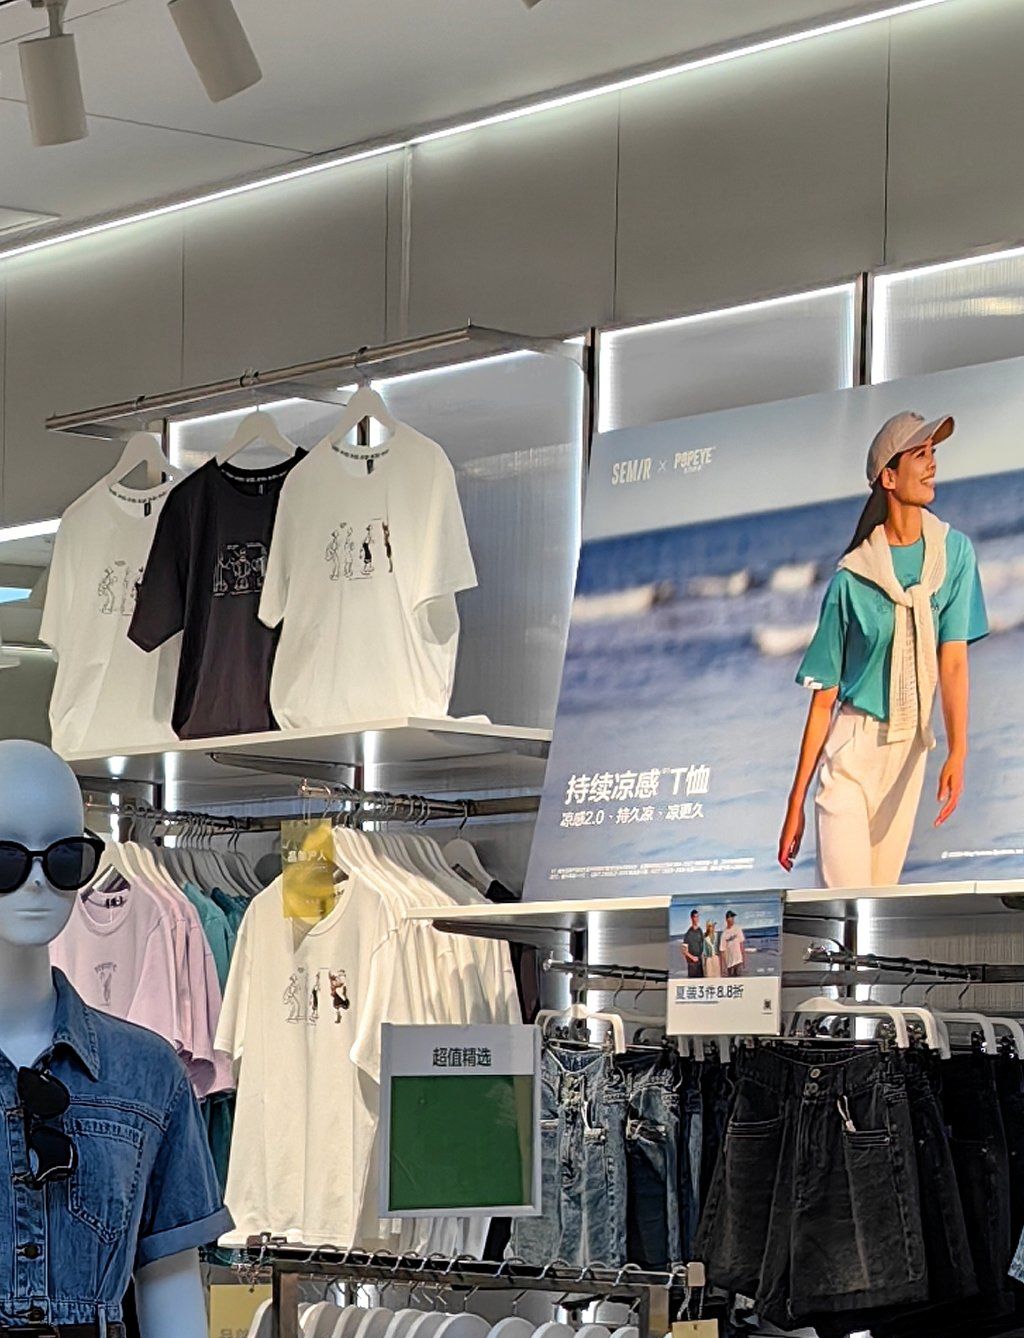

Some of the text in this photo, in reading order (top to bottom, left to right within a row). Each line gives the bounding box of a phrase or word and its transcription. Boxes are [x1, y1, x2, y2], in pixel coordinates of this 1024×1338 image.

[674, 446, 713, 469] POPEYE
[675, 984, 744, 1000] 夏装3件8.8折
[432, 1047, 492, 1067] 超值精选
